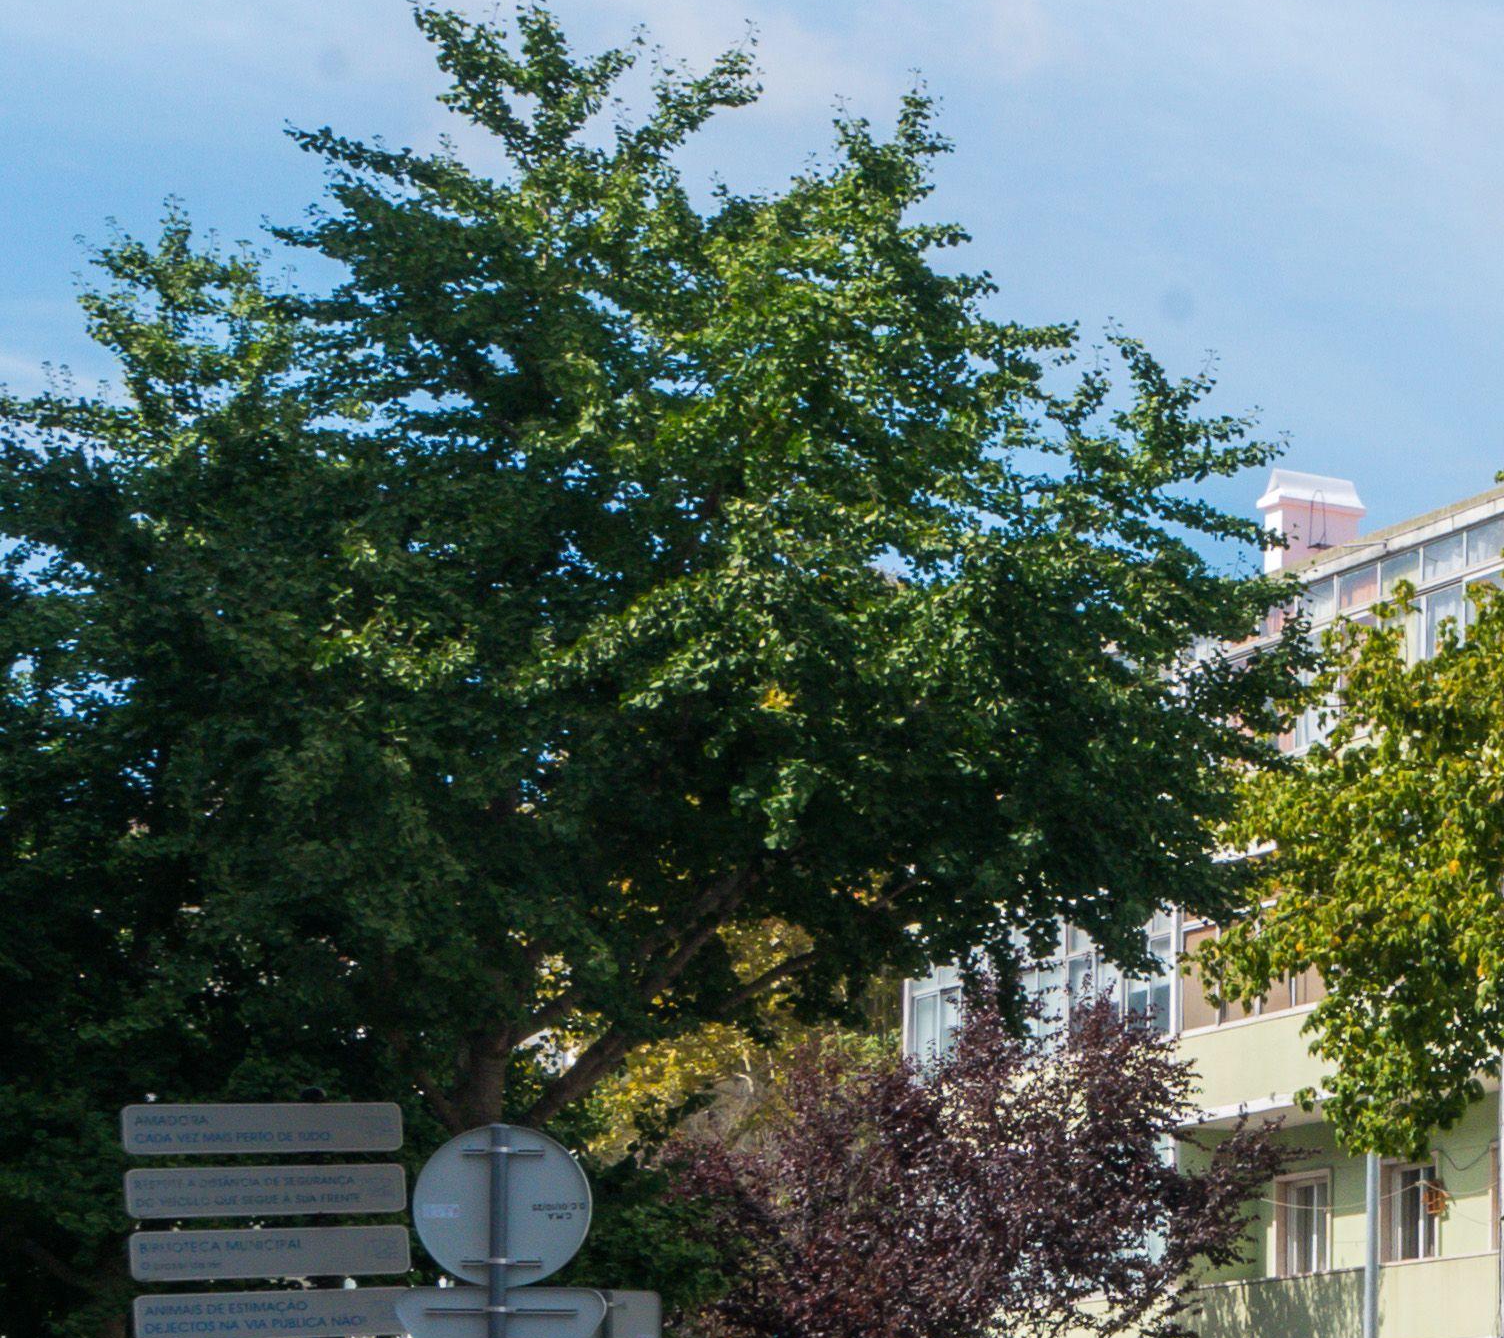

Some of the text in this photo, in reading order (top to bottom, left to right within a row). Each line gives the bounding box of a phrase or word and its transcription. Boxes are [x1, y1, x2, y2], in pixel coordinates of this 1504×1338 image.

[134, 1115, 209, 1127] AMADORA
[135, 1131, 331, 1144] CADA VEZ MAIS PERTO DE TUDO
[265, 1176, 280, 1187] DE
[214, 1195, 238, 1207] QUE
[242, 1194, 279, 1205] SEGUE
[295, 1193, 316, 1204] SUA
[320, 1192, 360, 1203] FRENTE
[225, 1239, 301, 1252] MUNICIPAL
[144, 1300, 309, 1317] ANIMAIS DE ESTIMAÇÃO
[144, 1321, 216, 1335] DEJECTOS
[219, 1320, 238, 1331] NA
[243, 1319, 267, 1330] VIA
